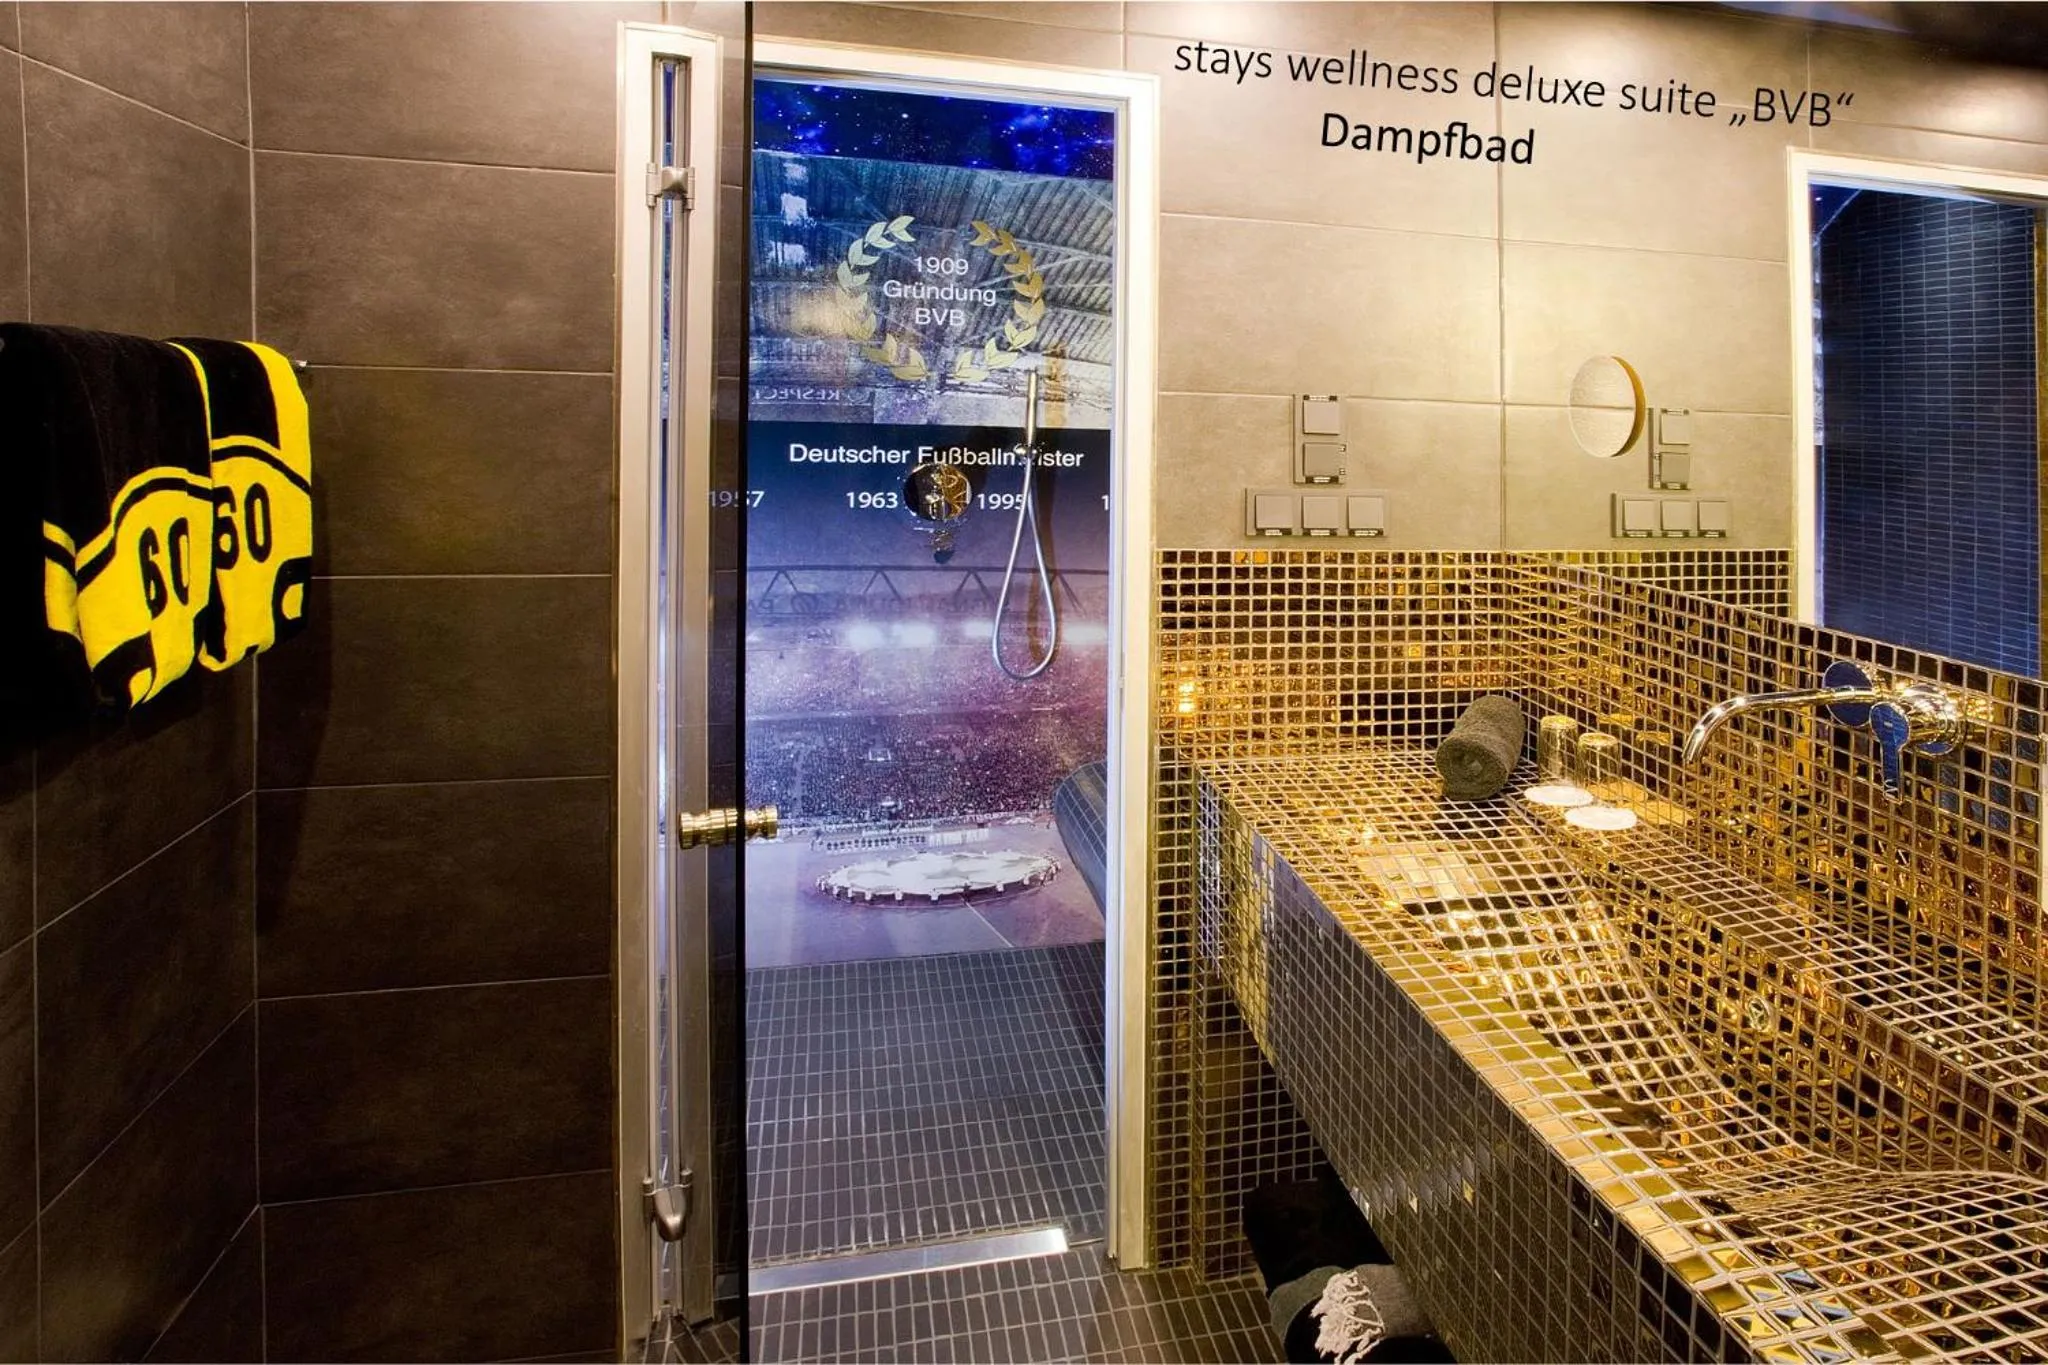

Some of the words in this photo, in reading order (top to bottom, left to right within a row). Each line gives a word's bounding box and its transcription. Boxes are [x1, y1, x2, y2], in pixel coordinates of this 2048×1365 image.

[913, 256, 969, 276] 1909
[882, 279, 997, 307] Gründung
[914, 307, 966, 327] BVB
[789, 443, 911, 464] Deutscher
[917, 446, 1084, 468] Fußballmister
[846, 491, 899, 509] 1963
